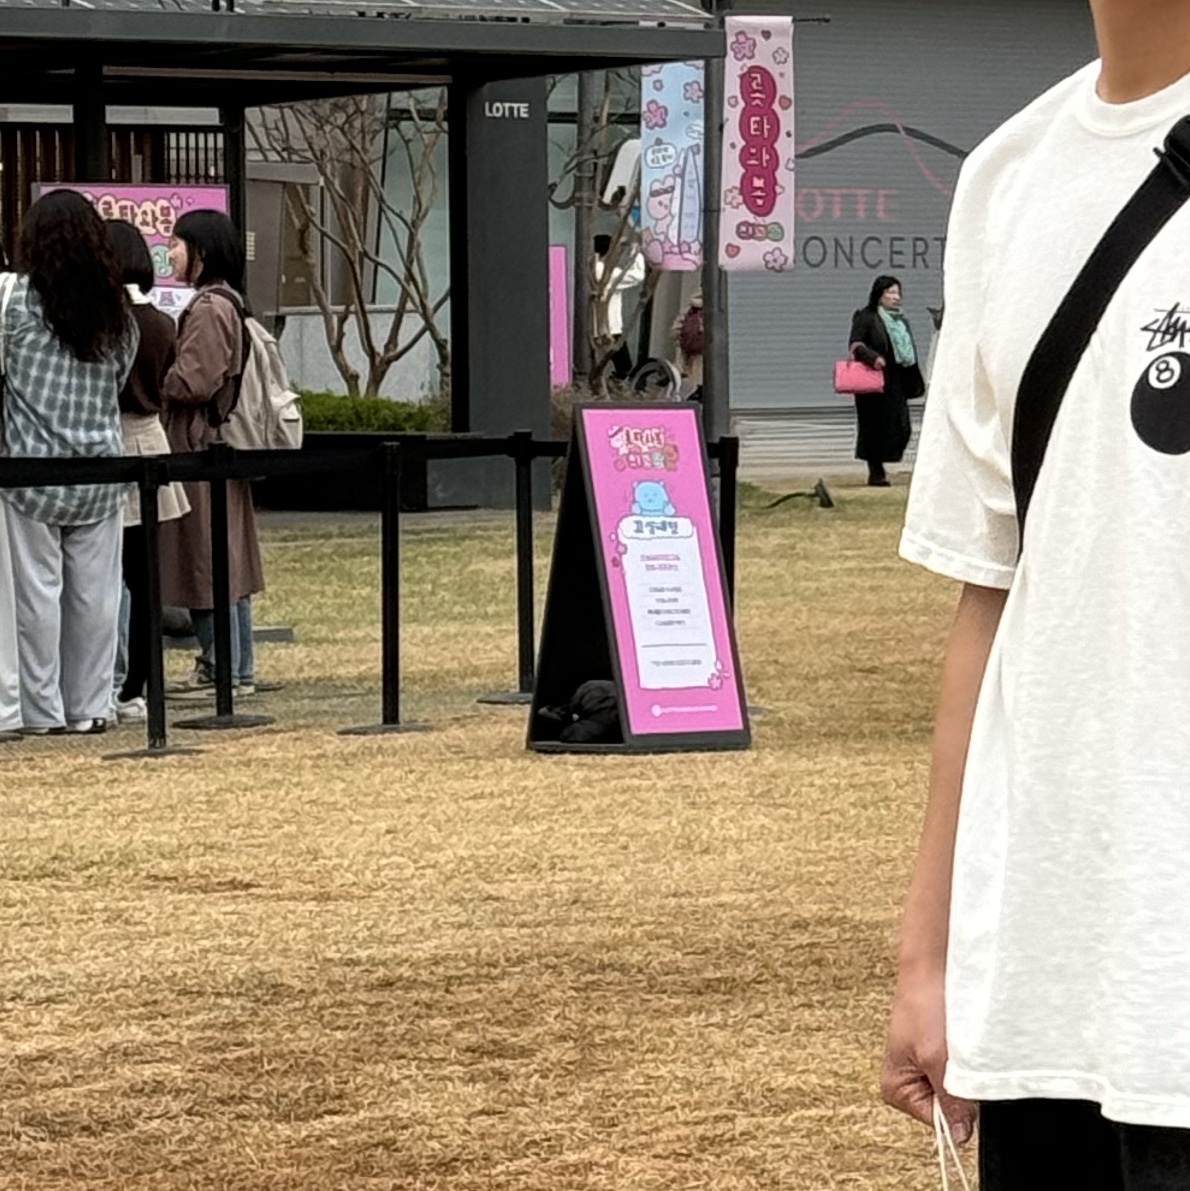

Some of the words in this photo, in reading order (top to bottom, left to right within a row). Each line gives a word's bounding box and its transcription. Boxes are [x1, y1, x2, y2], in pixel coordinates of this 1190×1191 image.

[484, 101, 530, 119] LOTTE
[797, 187, 897, 220] OTTE
[801, 235, 947, 269] ONCERT
[1155, 359, 1175, 384] 8
